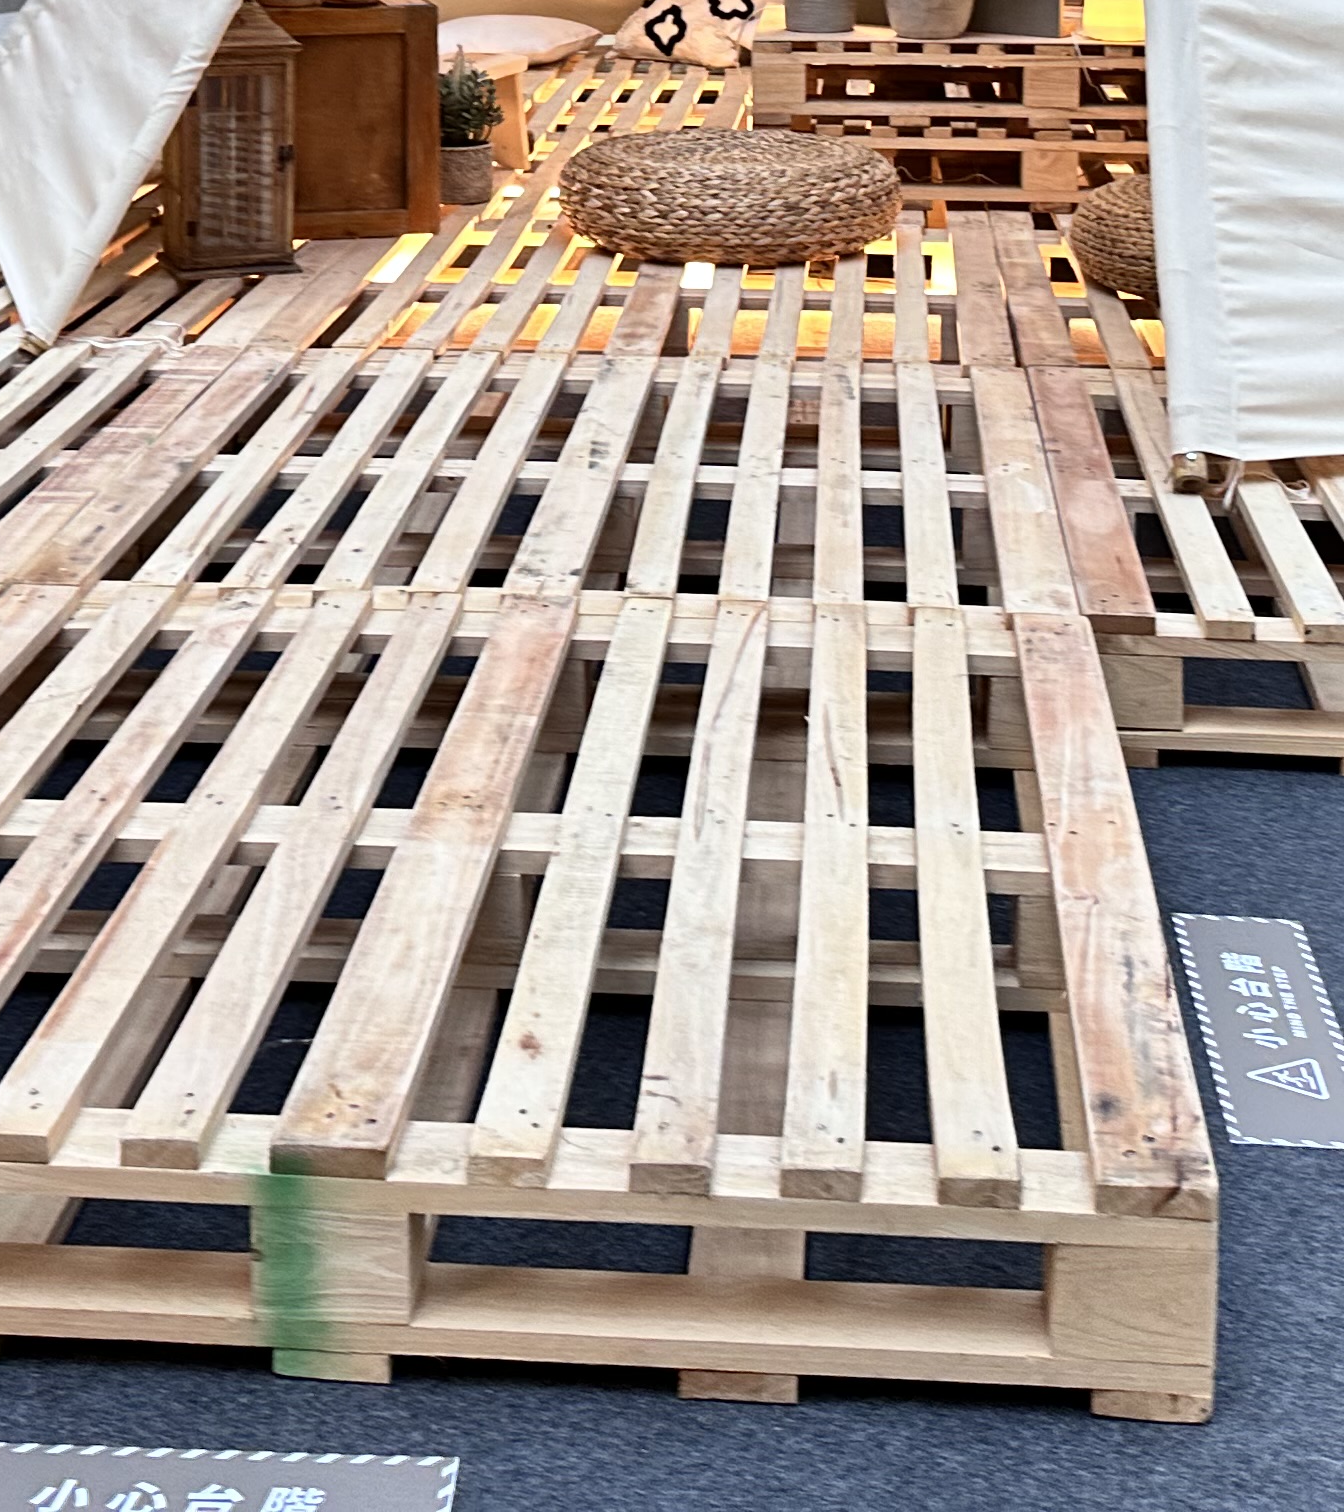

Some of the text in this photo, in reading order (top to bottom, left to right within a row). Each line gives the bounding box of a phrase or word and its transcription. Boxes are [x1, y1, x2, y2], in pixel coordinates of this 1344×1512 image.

[1270, 965, 1292, 990] STEP
[1219, 951, 1289, 1050] 小心台階
[1285, 1012, 1308, 1039] MIND
